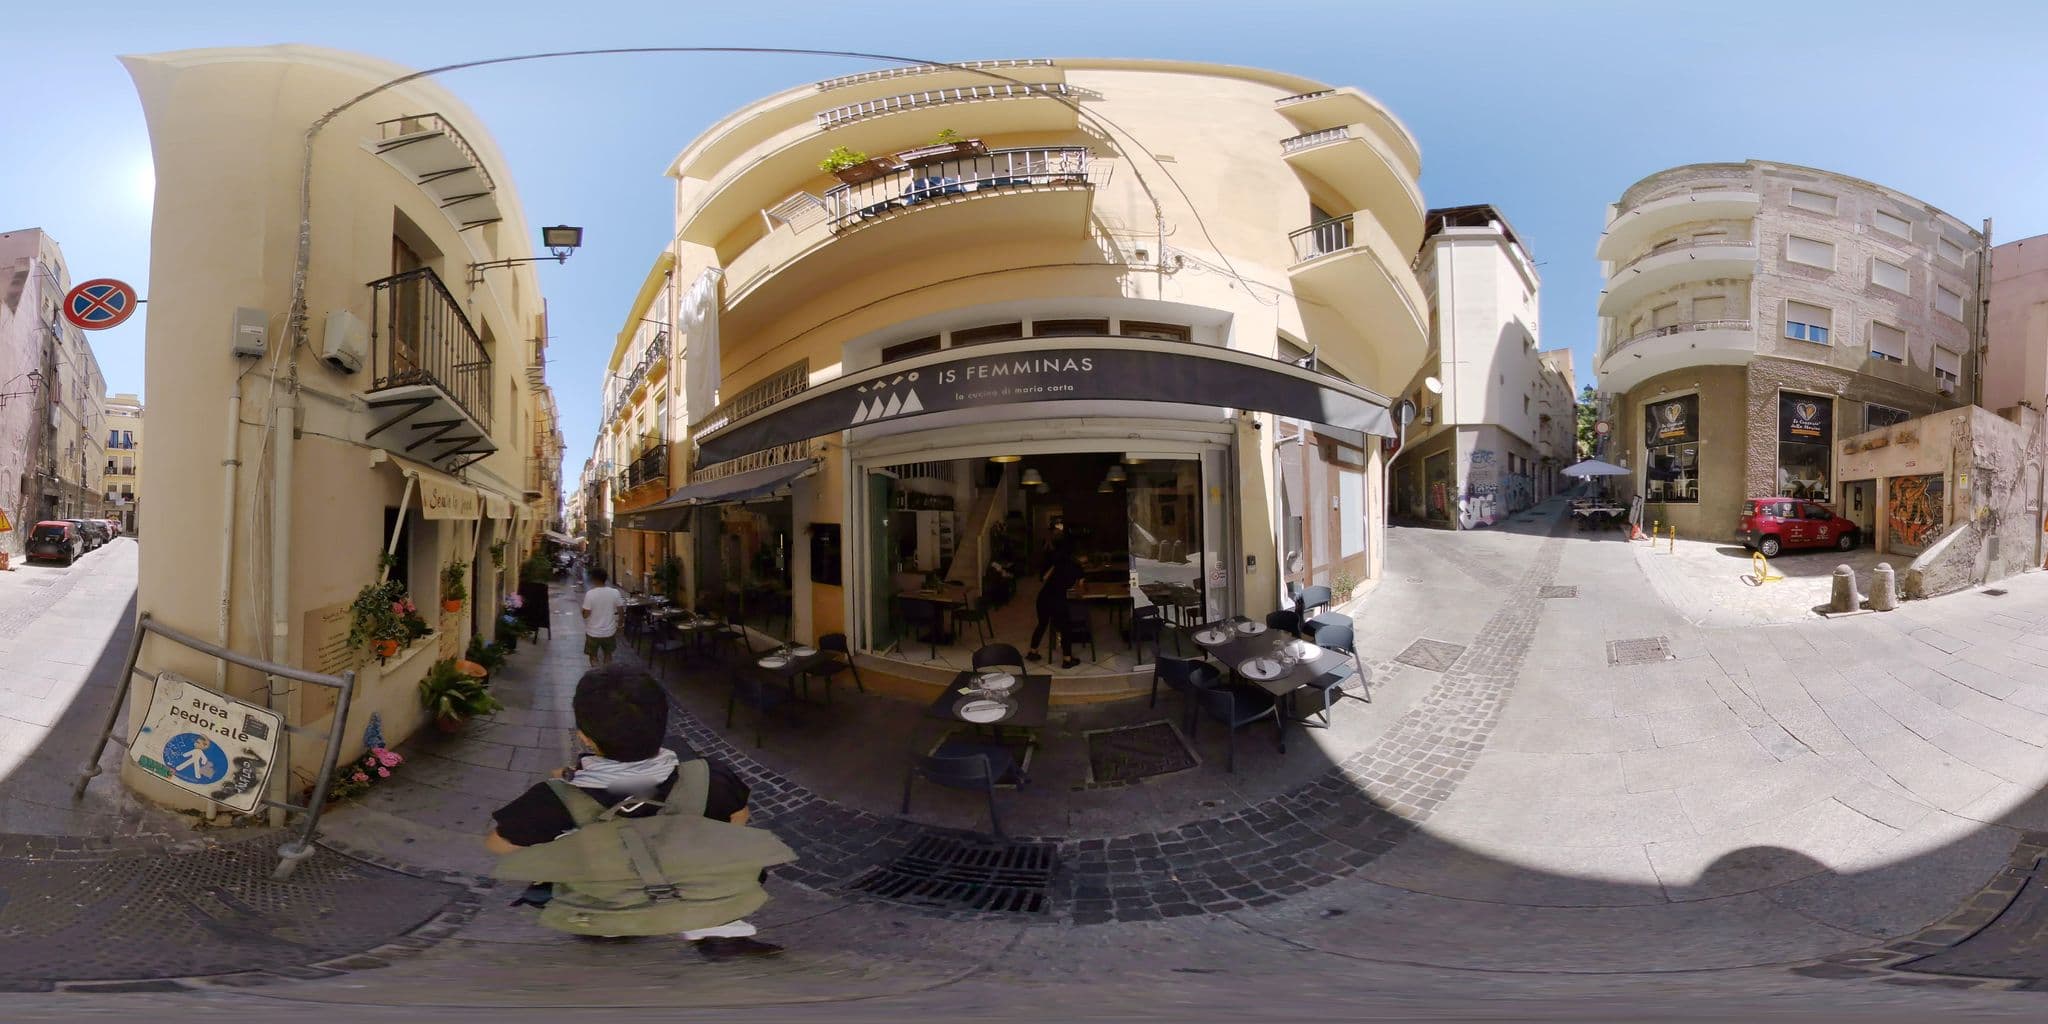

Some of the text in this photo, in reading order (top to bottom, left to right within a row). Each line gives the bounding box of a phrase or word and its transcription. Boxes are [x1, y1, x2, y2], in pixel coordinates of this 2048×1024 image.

[938, 357, 1093, 385] IS FEMMINAS
[955, 392, 964, 400] la
[1001, 386, 1011, 395] di
[1014, 384, 1043, 393] maria
[1047, 383, 1074, 392] carta
[192, 698, 228, 719] area
